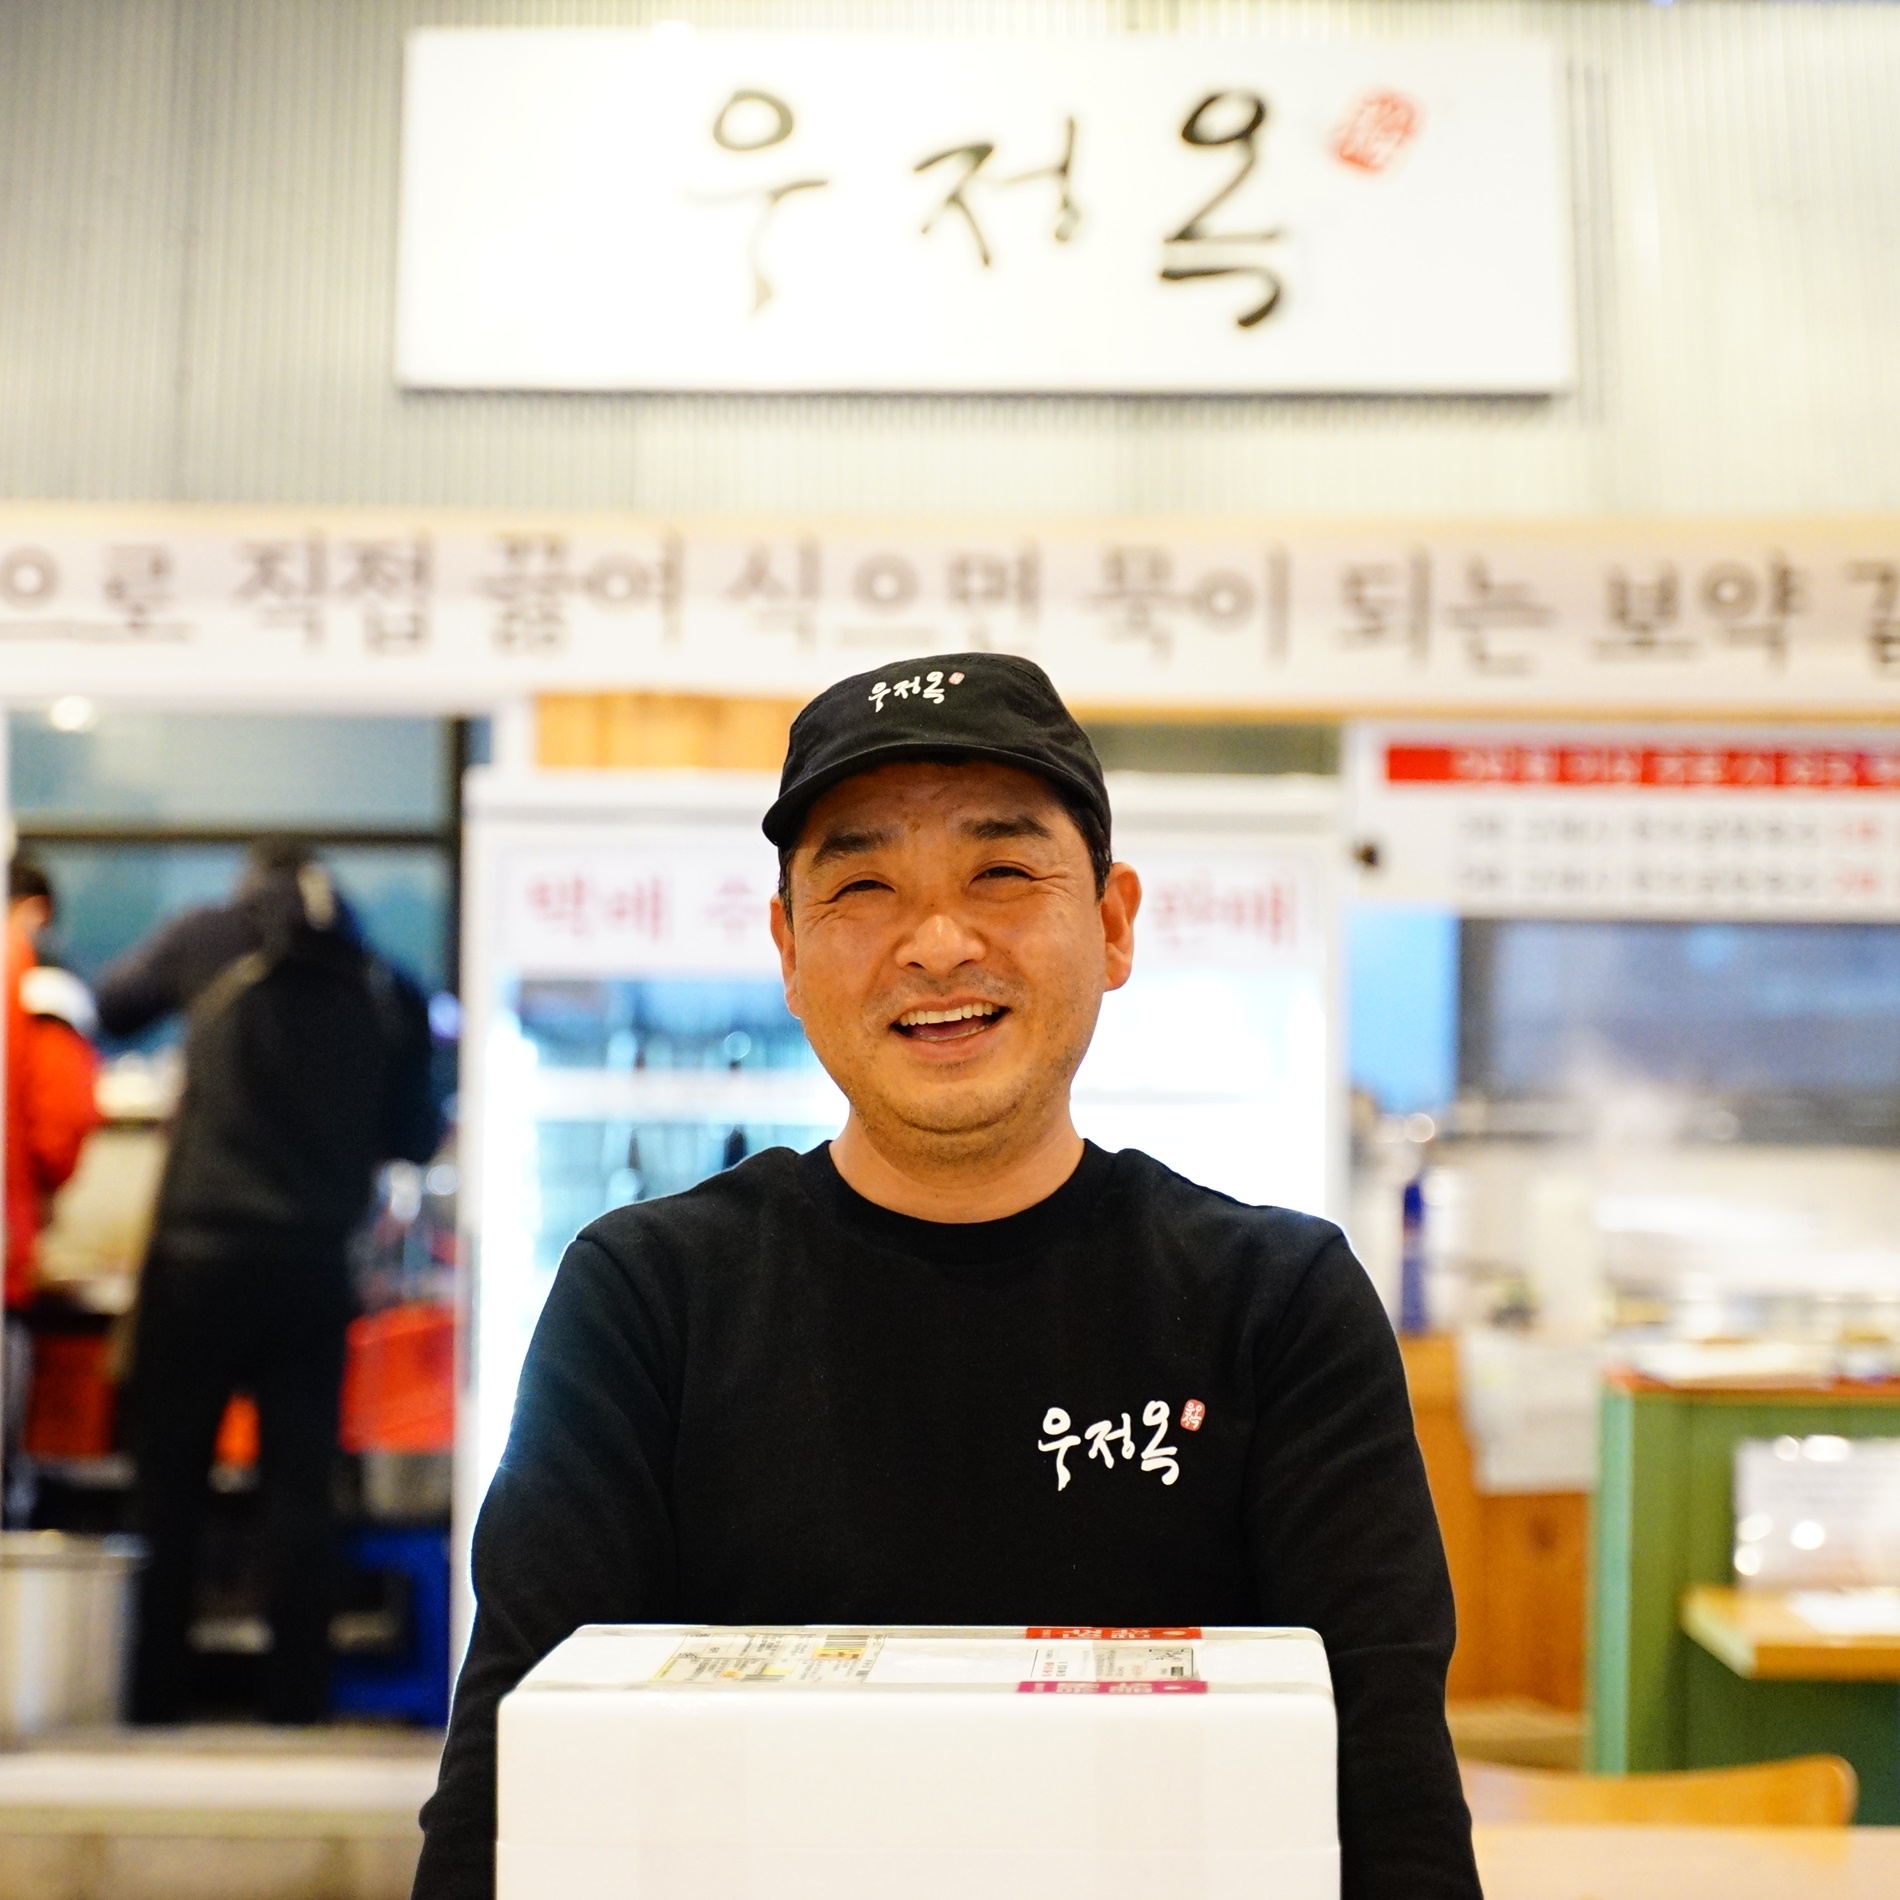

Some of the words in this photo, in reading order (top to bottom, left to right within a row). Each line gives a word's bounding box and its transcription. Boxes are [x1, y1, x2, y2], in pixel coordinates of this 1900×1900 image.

[683, 88, 1286, 328] 우정옥
[0, 543, 192, 642] 으로
[236, 529, 433, 655] 직접
[722, 537, 1040, 655] 식으면
[1337, 546, 1554, 674] 되는
[1592, 548, 1804, 674] 보약
[868, 671, 945, 713] 우정옥
[1038, 1400, 1180, 1492] 우정옥
